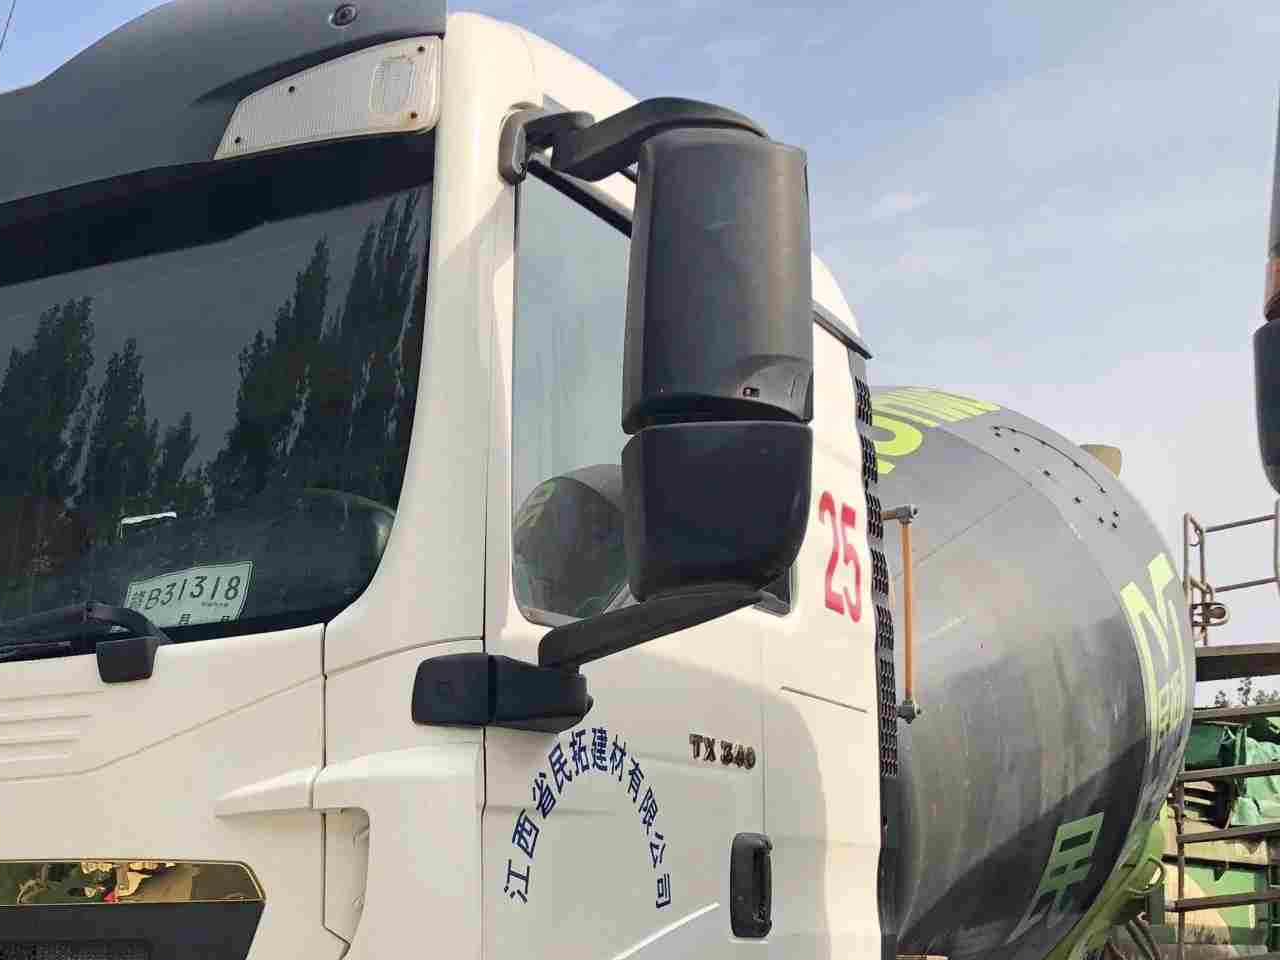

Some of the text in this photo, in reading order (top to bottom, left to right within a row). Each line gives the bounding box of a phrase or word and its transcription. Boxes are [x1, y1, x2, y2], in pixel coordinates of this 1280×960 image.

[819, 490, 862, 624] 25
[688, 733, 717, 762] TX
[504, 727, 672, 909] 江西省民拓建材有限公司
